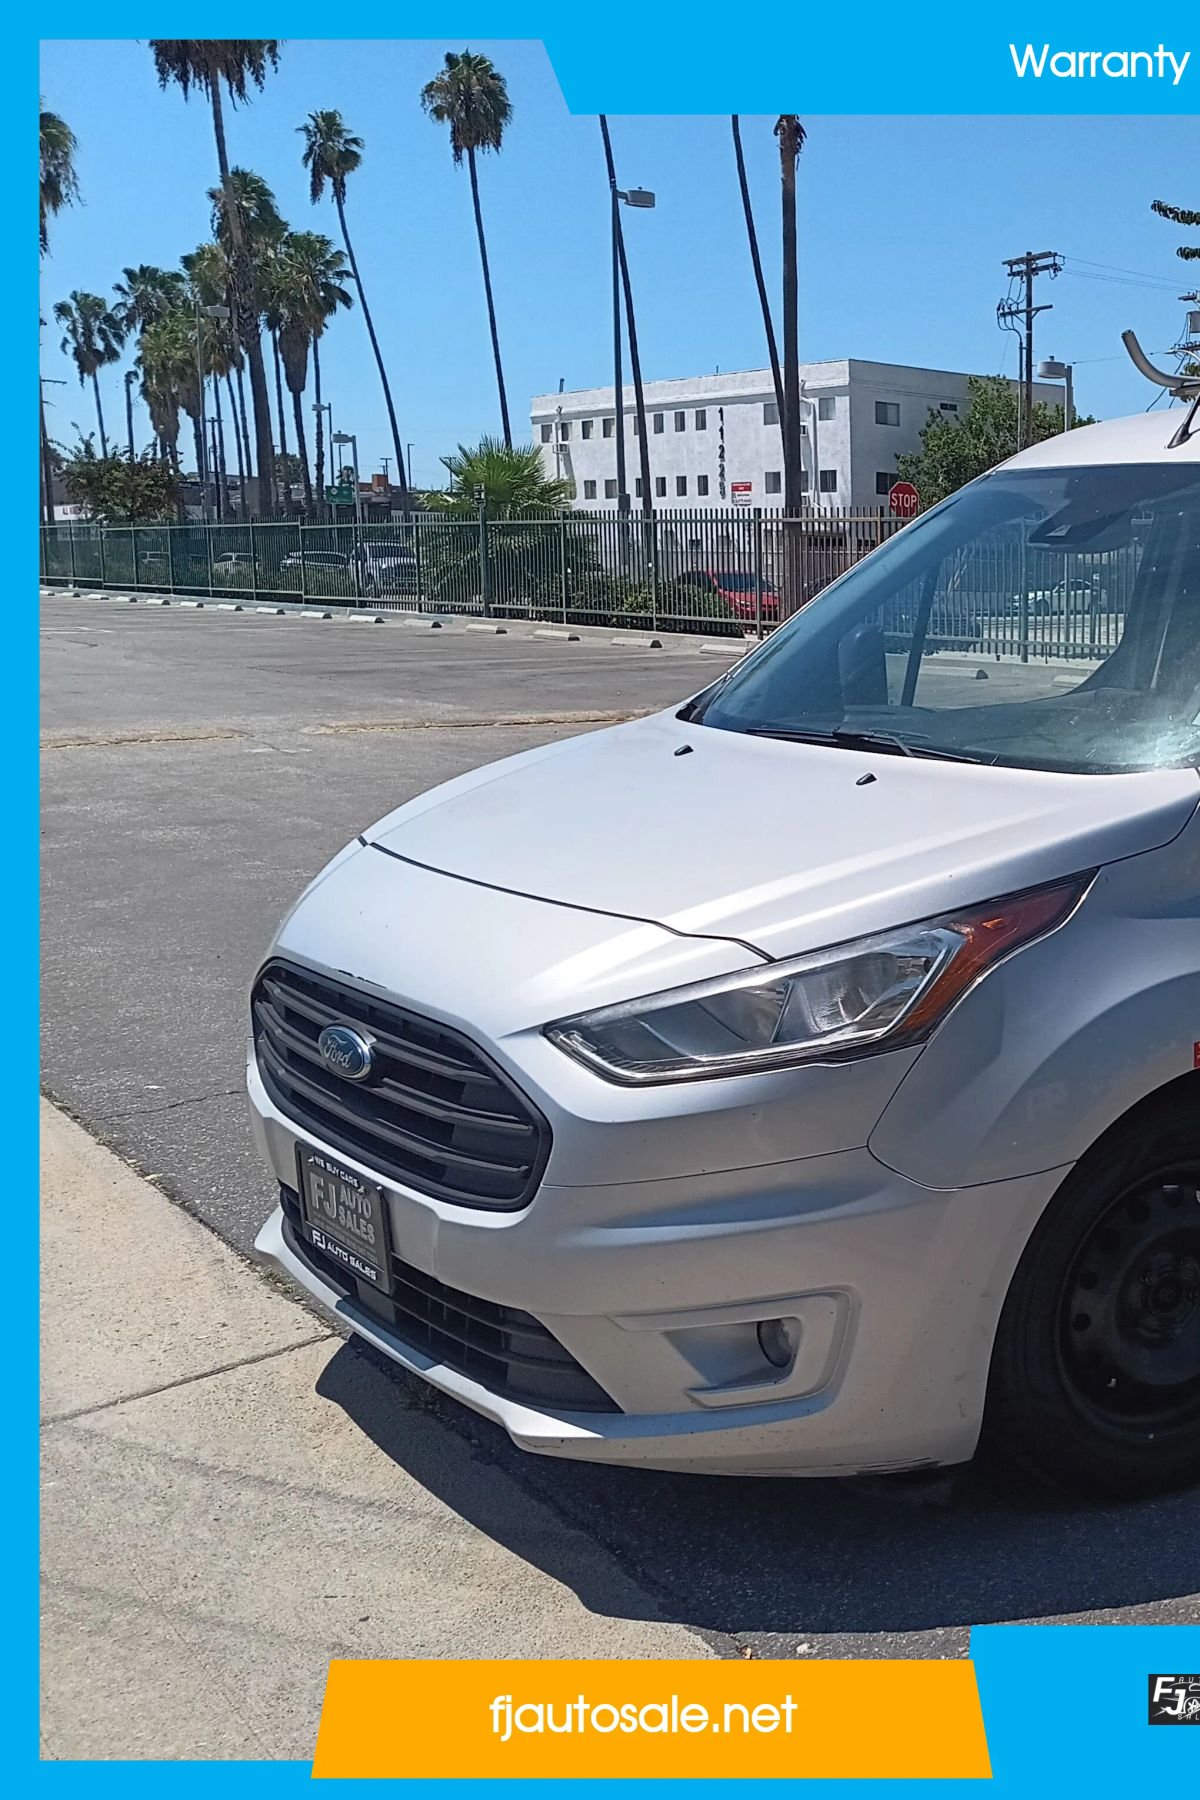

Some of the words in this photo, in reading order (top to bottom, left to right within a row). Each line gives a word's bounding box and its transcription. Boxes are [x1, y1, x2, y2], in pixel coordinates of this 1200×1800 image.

[891, 493, 917, 509] STOP
[324, 1034, 352, 1068] Ford
[309, 1172, 337, 1219] FJ
[340, 1184, 372, 1219] AUTO
[340, 1170, 359, 1187] CARS
[338, 1205, 376, 1245] SALES
[312, 1229, 326, 1250] FJ
[327, 1242, 349, 1263] AUTO
[349, 1255, 378, 1281] SALES
